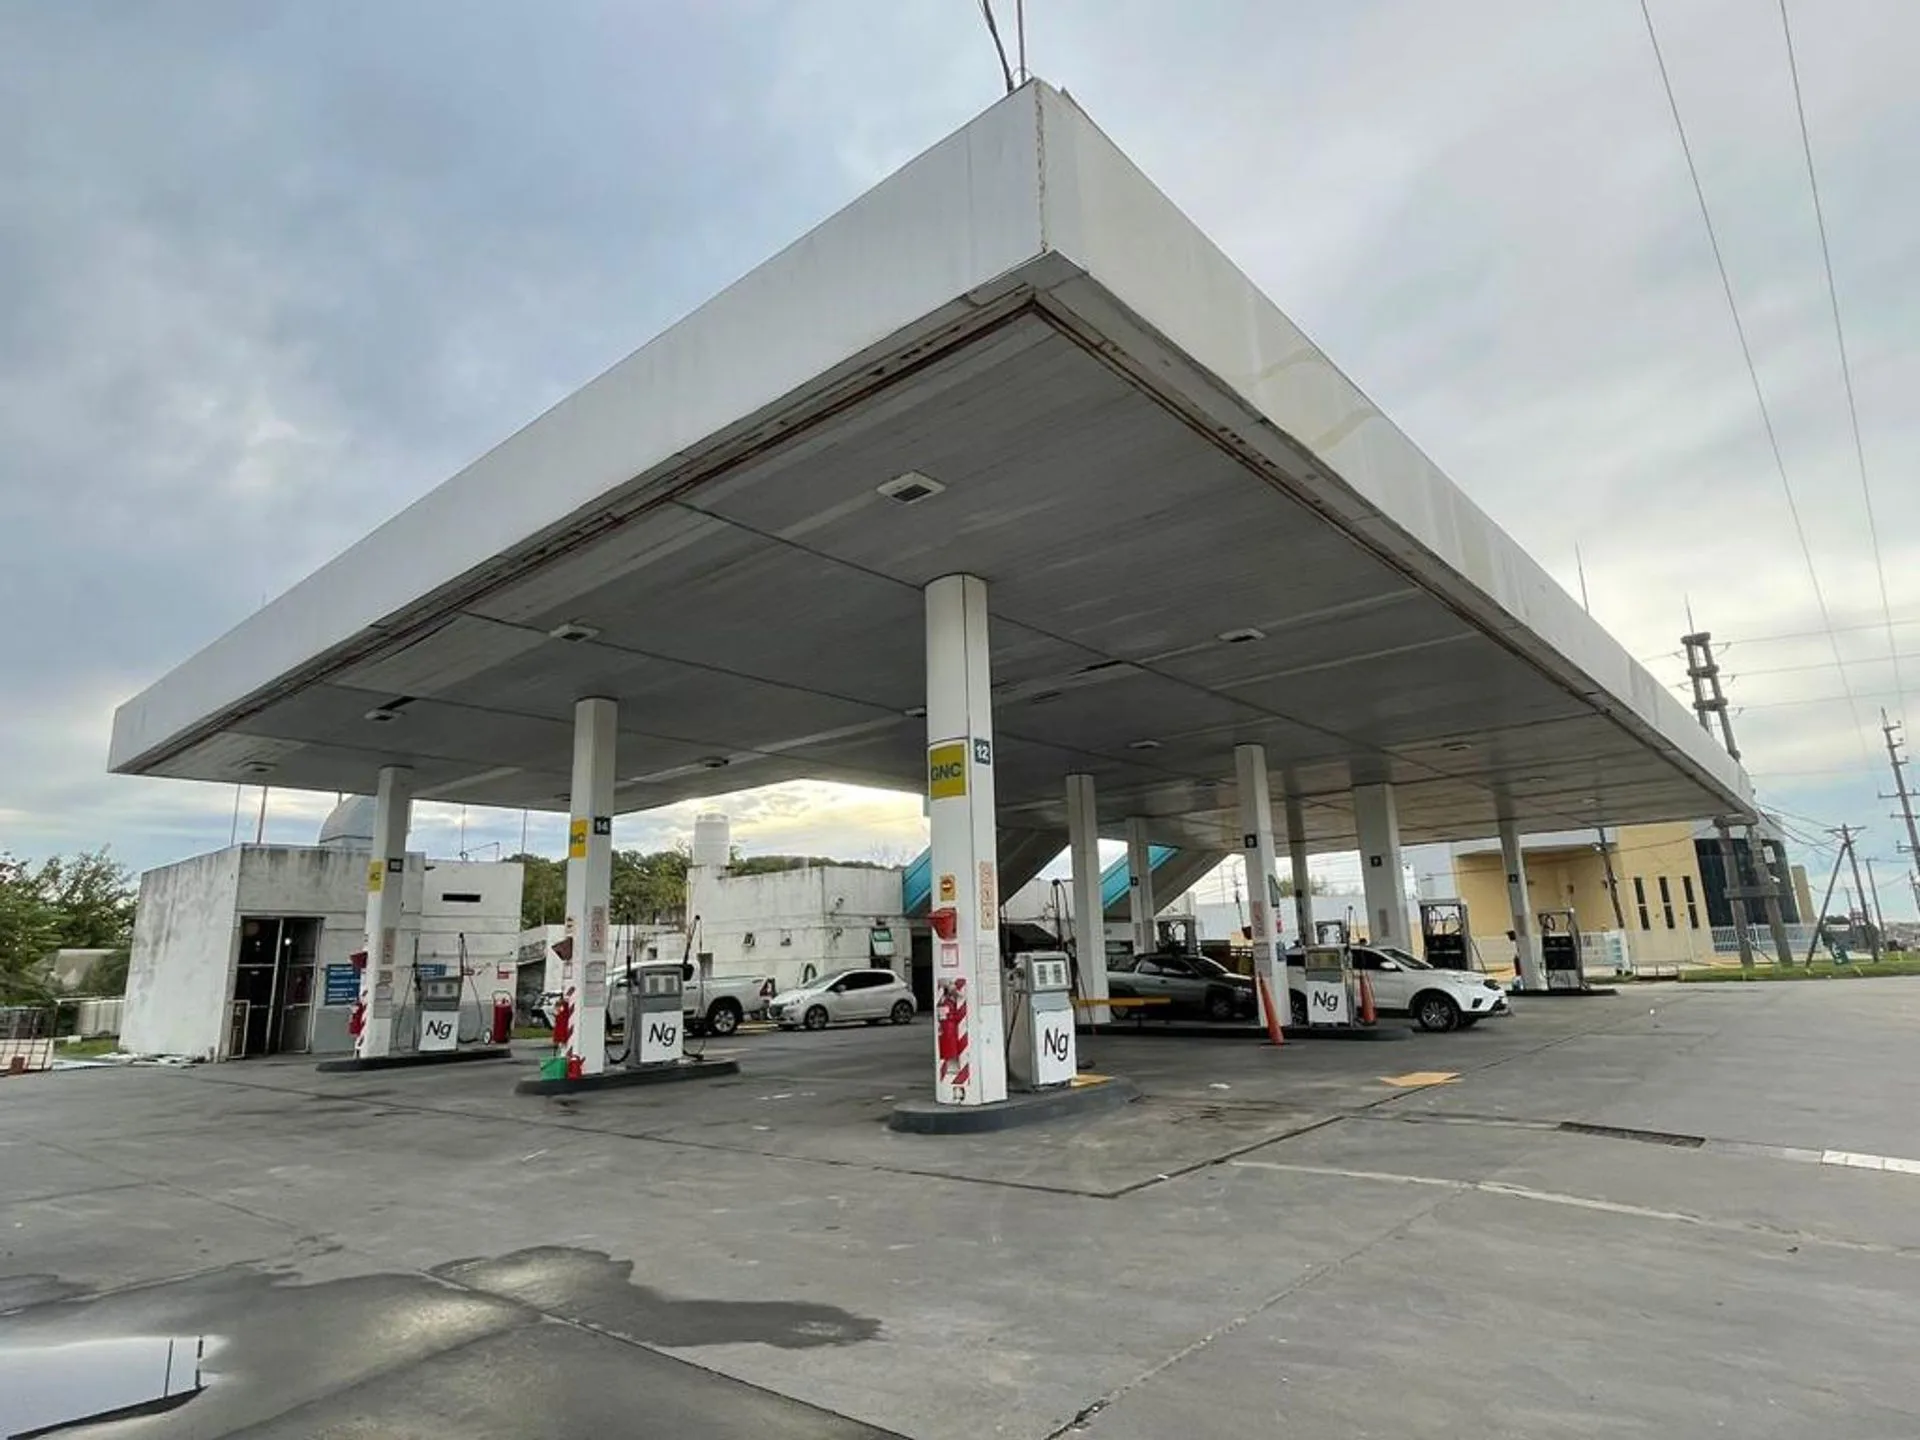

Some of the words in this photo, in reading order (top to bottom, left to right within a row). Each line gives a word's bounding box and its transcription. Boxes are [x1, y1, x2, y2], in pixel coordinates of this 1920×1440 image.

[976, 744, 990, 760] 12
[931, 762, 961, 781] GNC
[1312, 991, 1339, 1012] Ng
[426, 1020, 452, 1040] Ng
[648, 1022, 676, 1047] Ng
[1044, 1027, 1069, 1062] Ng
